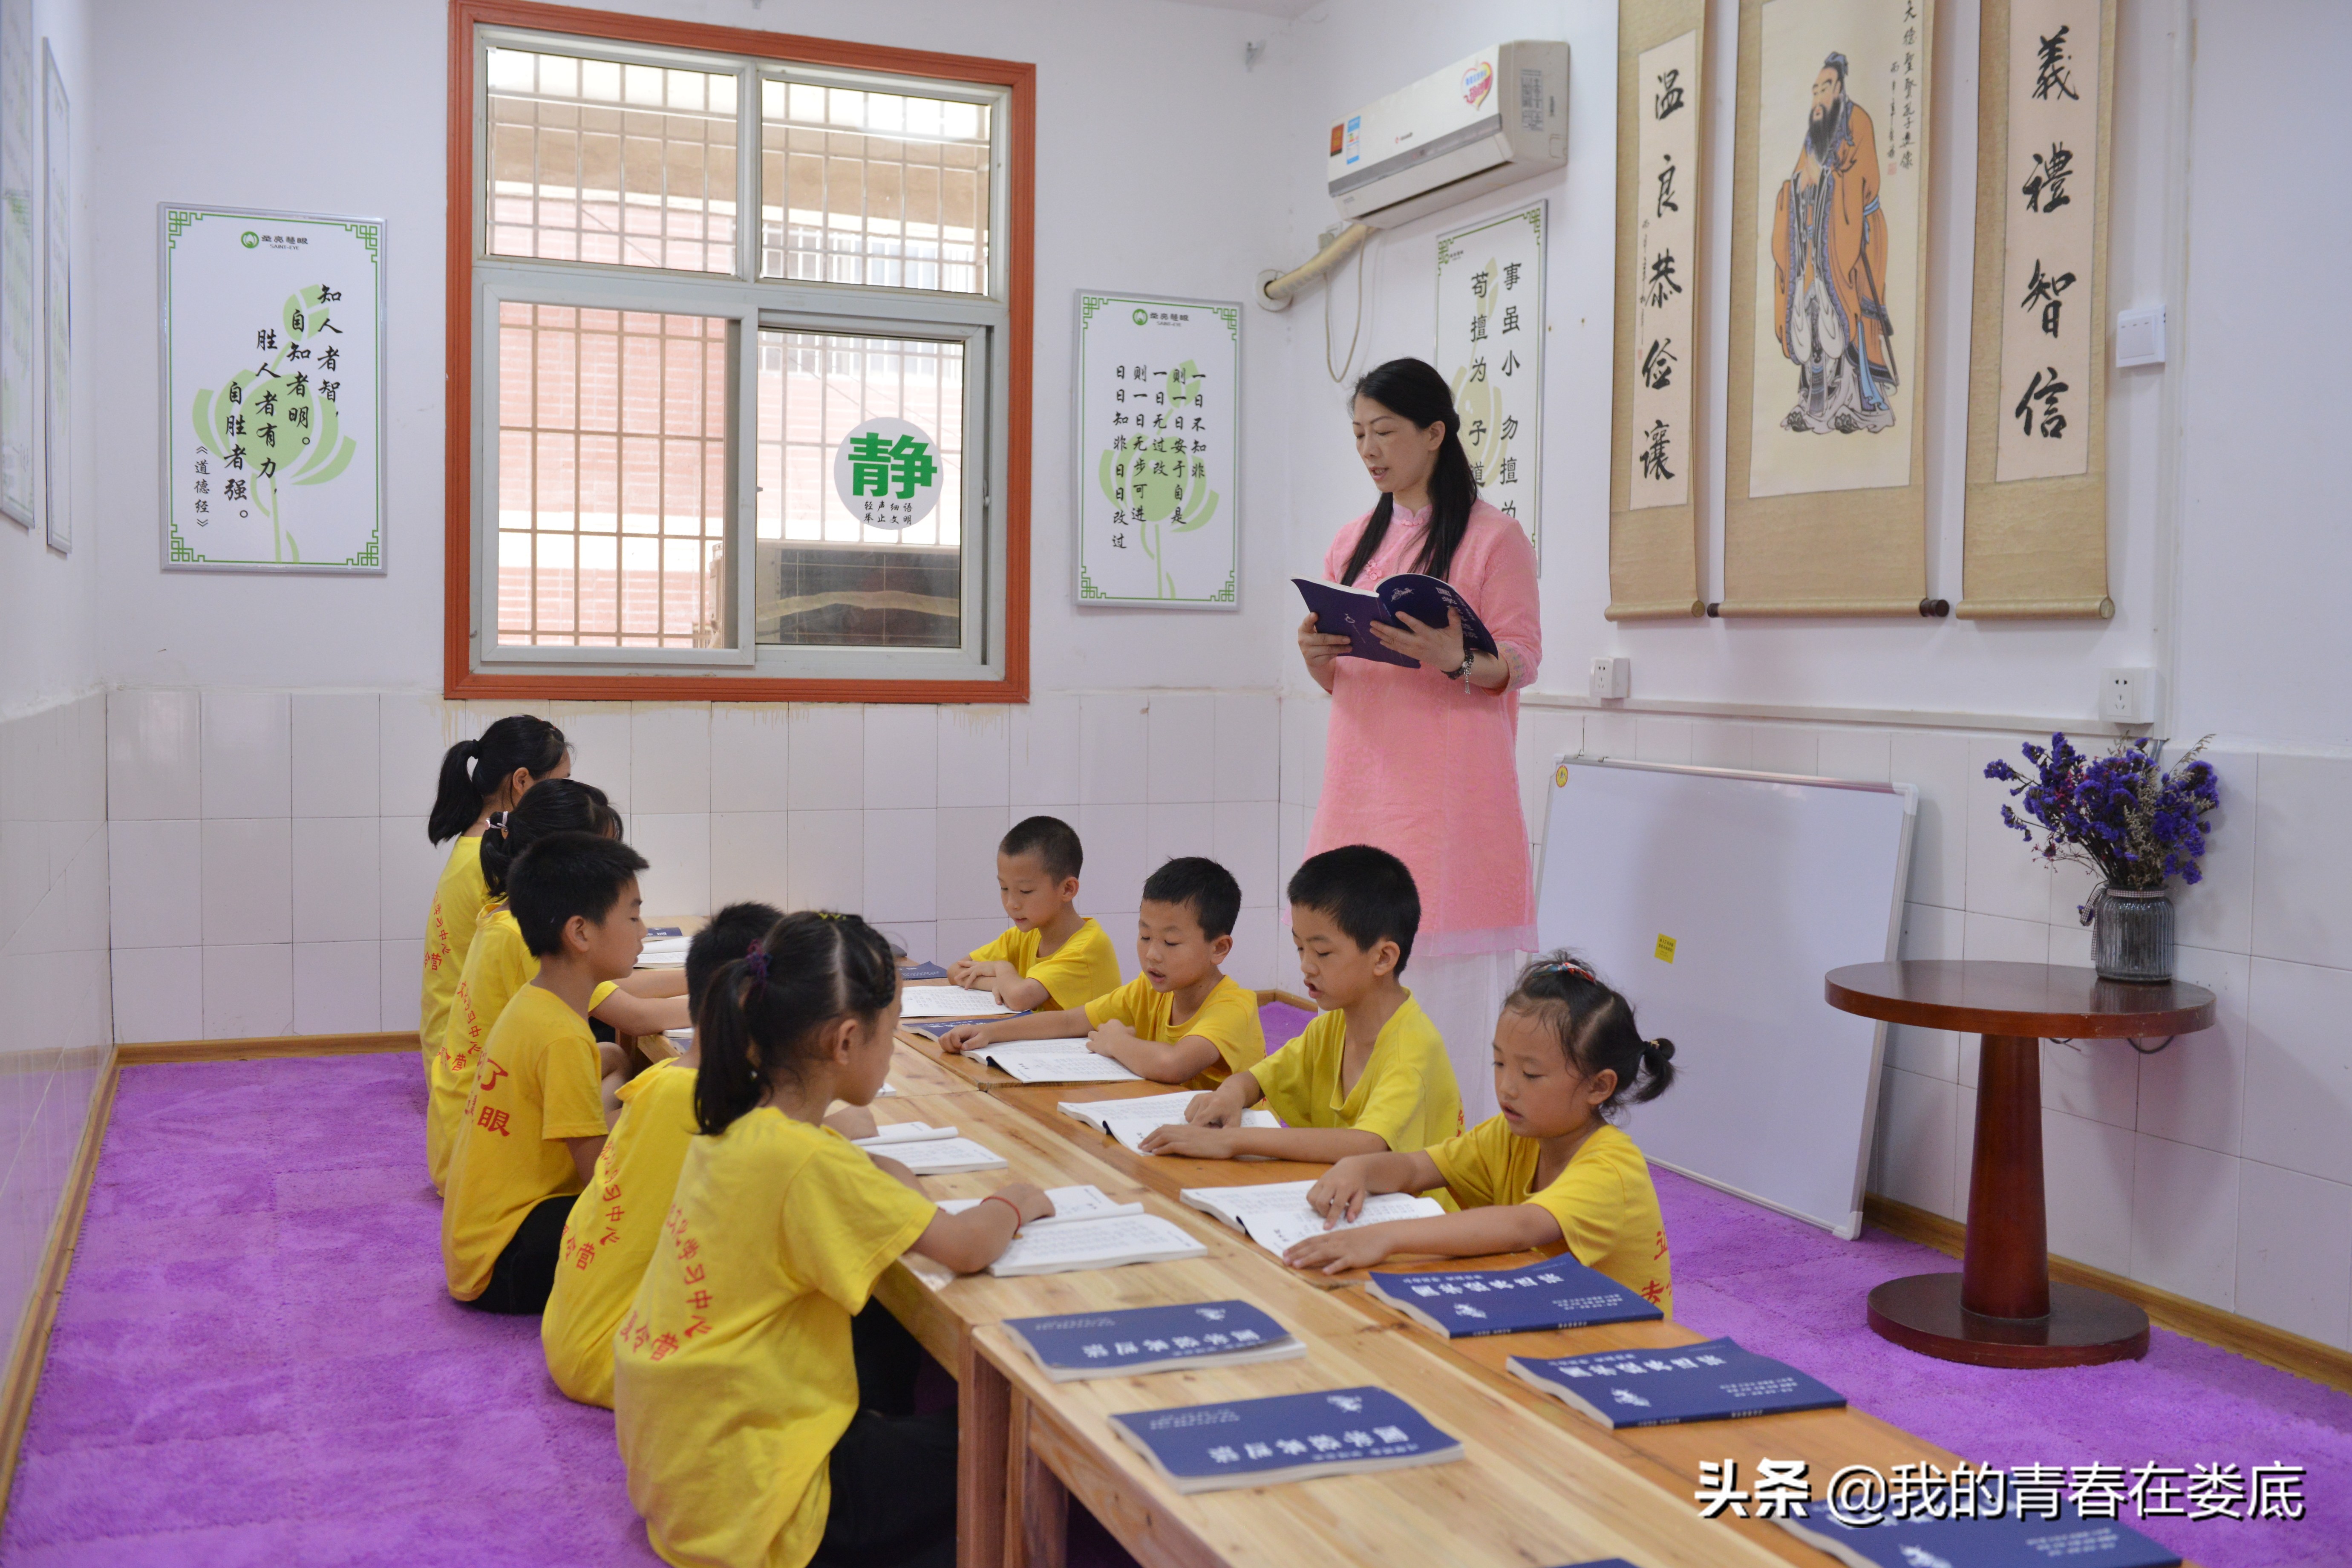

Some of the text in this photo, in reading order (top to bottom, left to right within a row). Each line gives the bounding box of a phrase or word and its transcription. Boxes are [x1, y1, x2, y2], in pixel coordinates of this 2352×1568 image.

[1470, 272, 1489, 382] 苟擅为
[1501, 262, 1522, 377] 事虽小
[848, 432, 937, 499] 静
[1112, 366, 1129, 549] 日日知非日日改过
[1131, 365, 1147, 522] 则一日无步可进
[1153, 370, 1168, 476] 一日无过改
[1170, 368, 1187, 524] 则一日安于自是
[1192, 374, 1207, 478] 一日不知非
[194, 445, 210, 527] 《道德经》
[864, 500, 913, 513] 轻声细语
[864, 512, 912, 525] 举止文明
